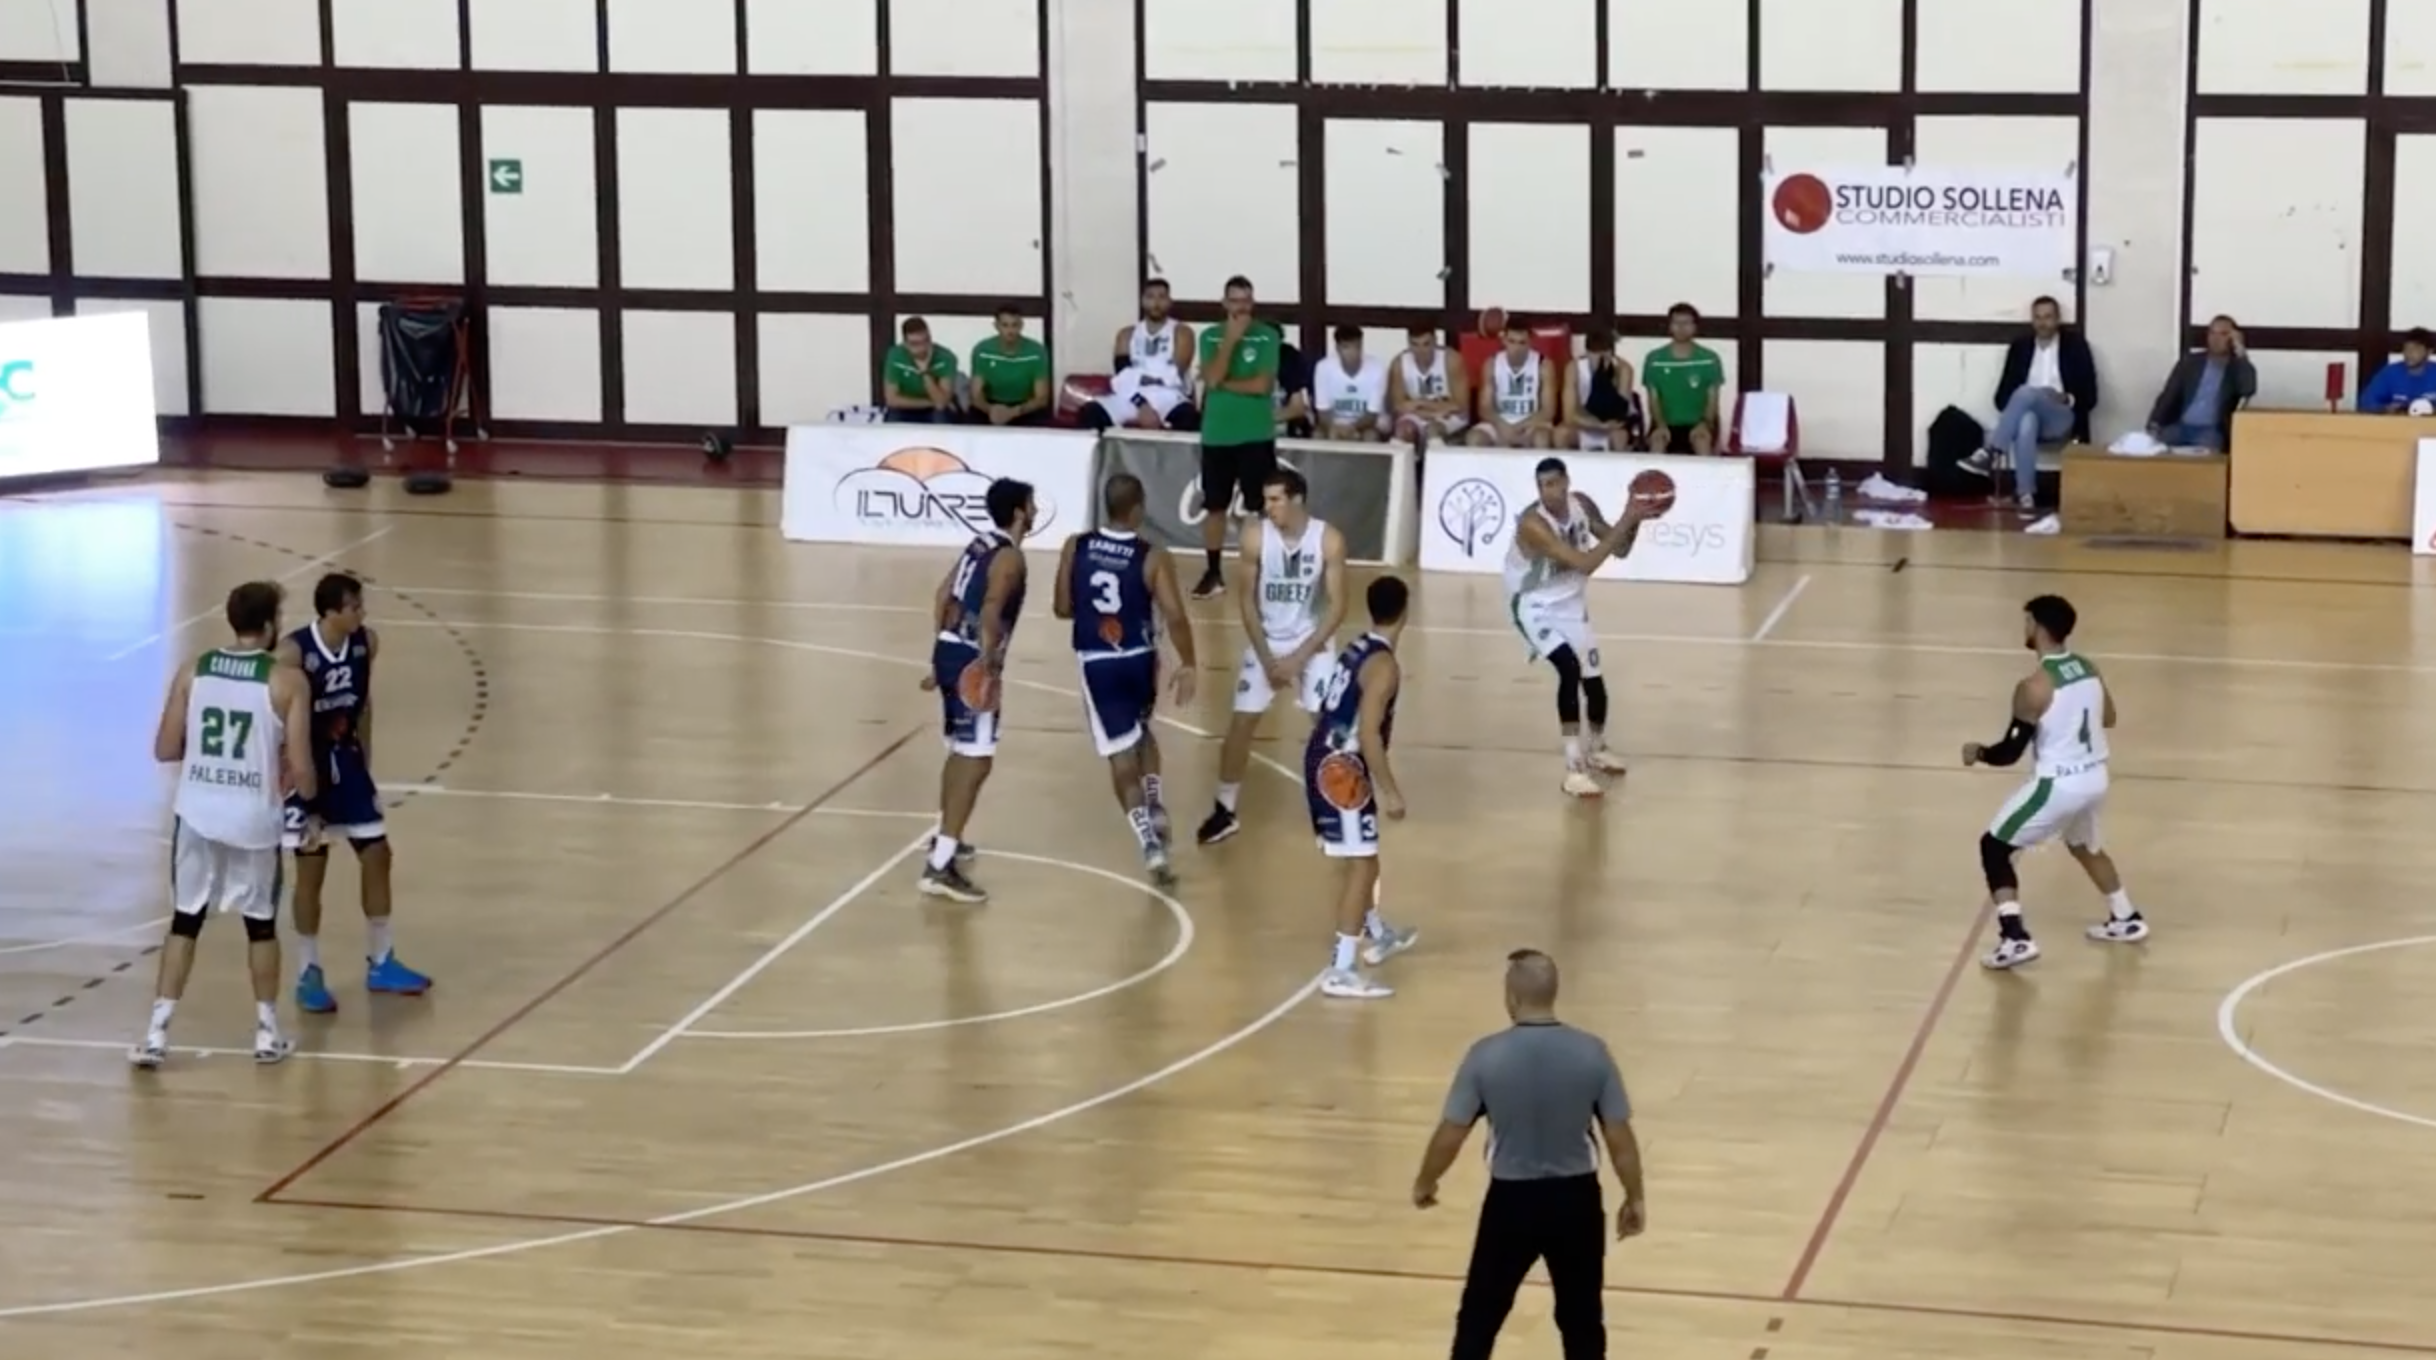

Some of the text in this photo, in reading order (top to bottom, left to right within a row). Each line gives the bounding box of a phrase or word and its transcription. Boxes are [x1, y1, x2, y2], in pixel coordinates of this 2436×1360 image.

[1836, 185, 2065, 211] STUDIO SOLLENA
[1836, 209, 2066, 228] COMMERCIALISTI
[1836, 252, 2001, 267] www.studiosollena.com
[1089, 570, 1123, 614] 3
[325, 666, 353, 692] 22
[202, 706, 253, 759] 27
[2078, 707, 2092, 753] 4
[190, 764, 262, 788] PALERMO
